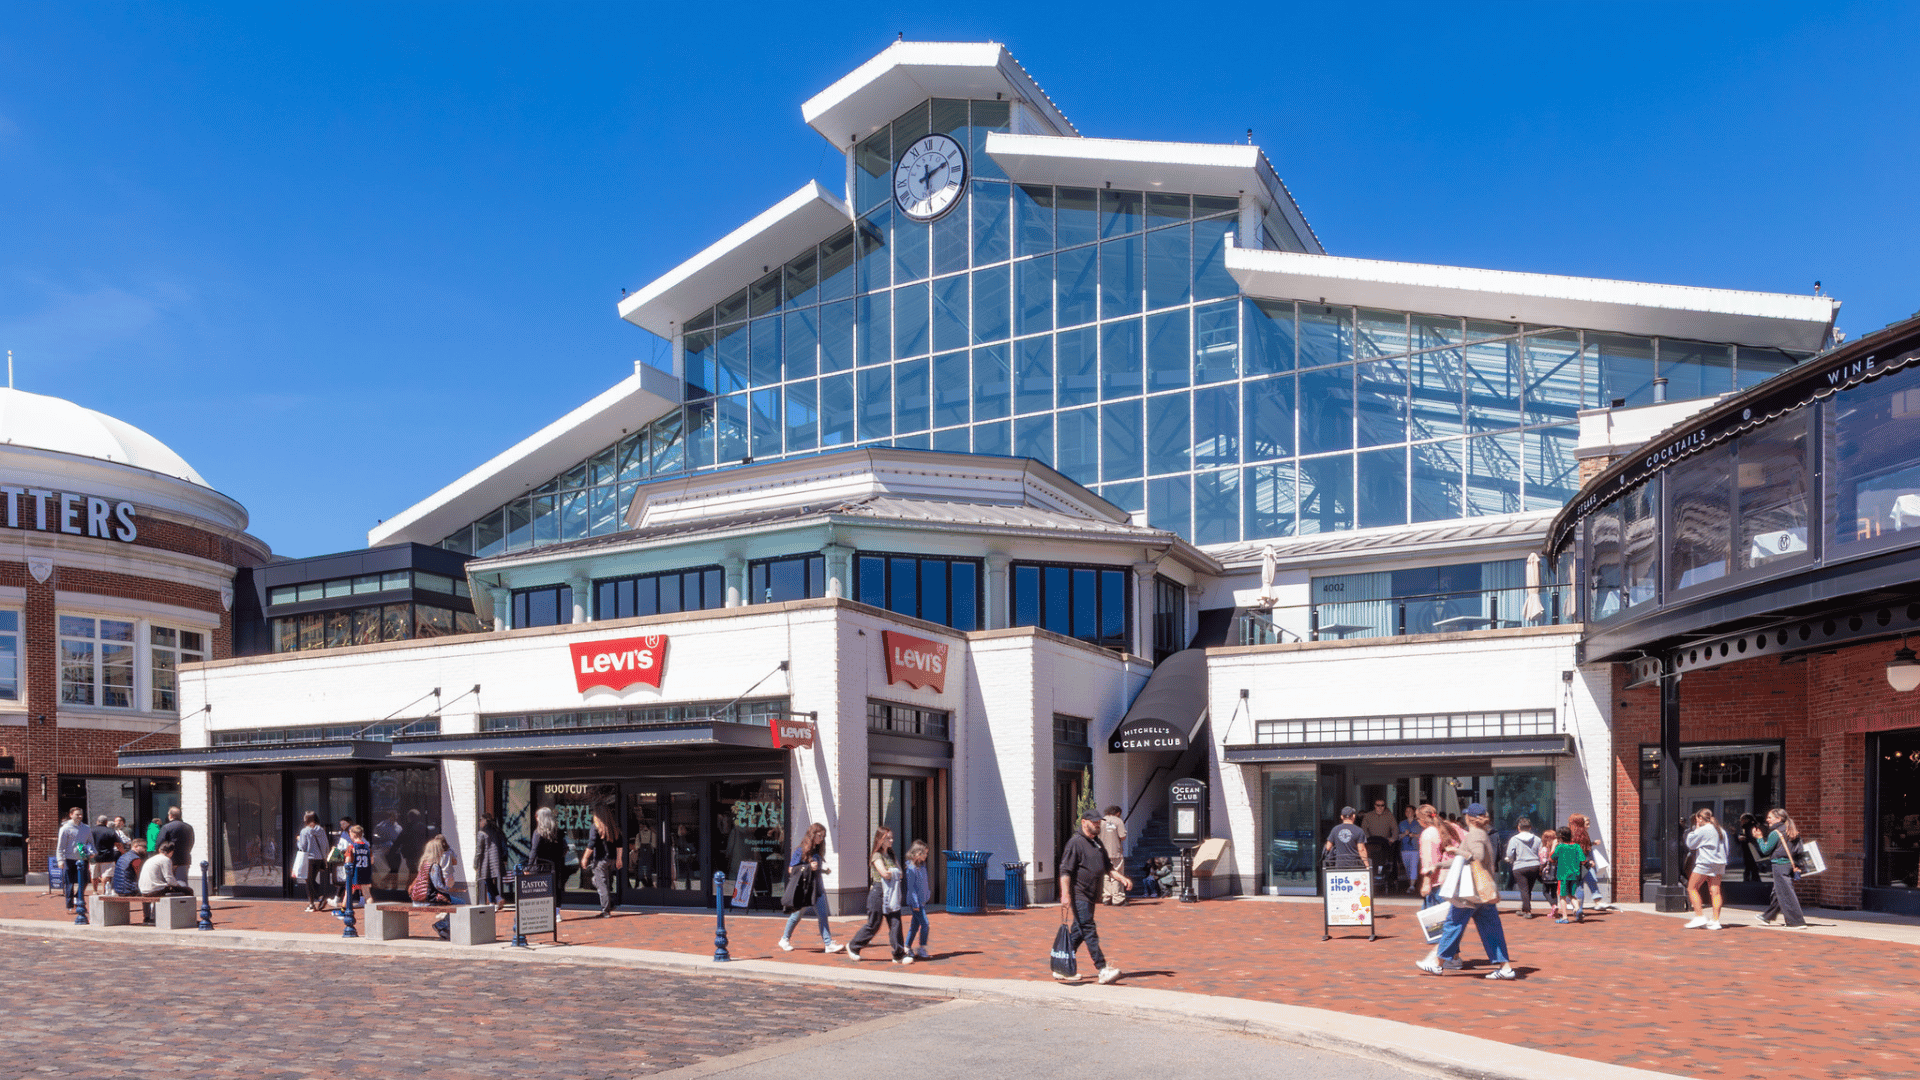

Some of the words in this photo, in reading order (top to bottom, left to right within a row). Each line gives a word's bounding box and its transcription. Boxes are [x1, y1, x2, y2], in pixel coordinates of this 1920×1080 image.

[1828, 355, 1875, 384] WINE
[1646, 429, 1706, 468] COCKTAILS
[1577, 493, 1597, 516] STEAKS
[1323, 583, 1345, 592] 4002
[1124, 727, 1170, 736] MITCHELL'S
[1114, 739, 1150, 748] OCEAN
[1154, 738, 1181, 746] CLUB
[544, 784, 588, 794] BOOTCUT
[1172, 786, 1200, 794] OCEAN
[556, 804, 593, 818] STYL
[557, 815, 593, 829] CLAS
[738, 813, 781, 828] CLAS
[1331, 884, 1353, 892] shop
